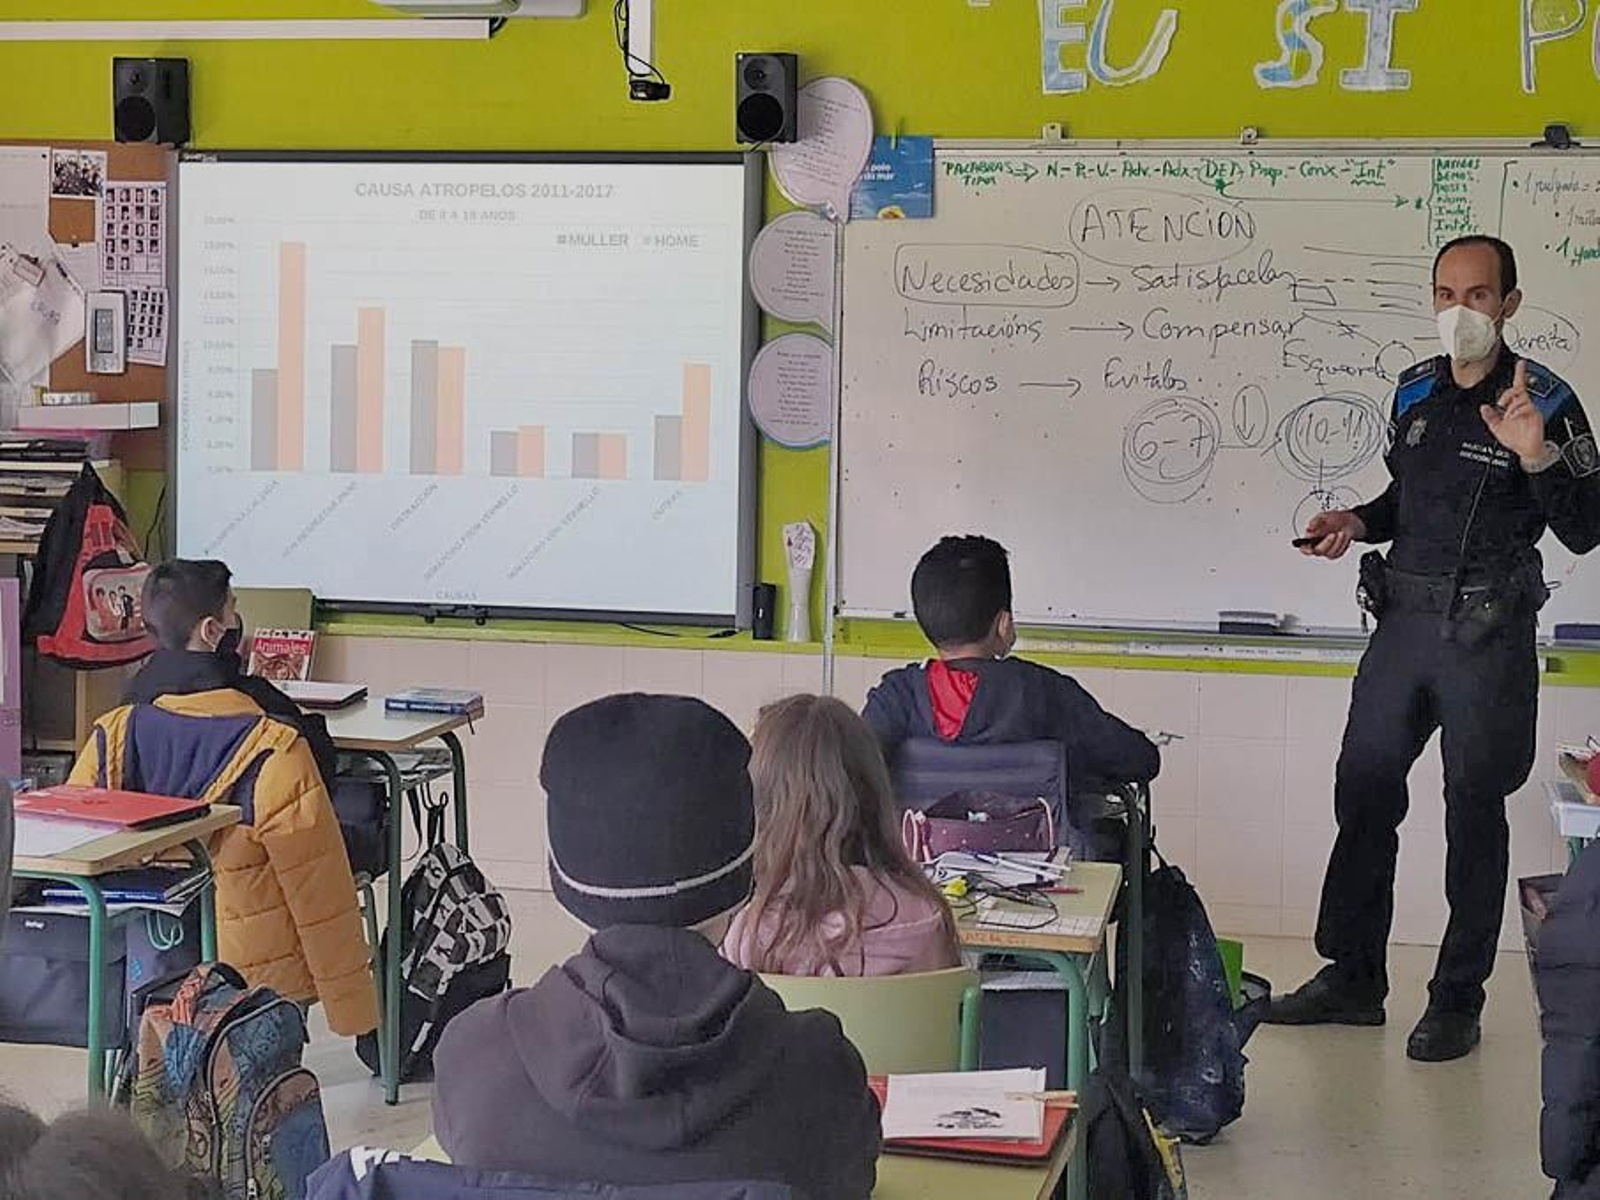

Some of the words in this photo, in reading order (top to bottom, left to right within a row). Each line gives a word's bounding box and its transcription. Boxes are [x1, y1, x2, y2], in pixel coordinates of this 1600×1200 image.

[1252, 0, 1418, 92] SI
[1520, 0, 1600, 94] P
[354, 182, 413, 198] CAUSA
[419, 182, 526, 198] ATROPELOS
[530, 181, 614, 198] 2011-2017
[568, 233, 629, 248] MULLER
[654, 234, 700, 249] HOME
[902, 260, 1074, 293] Necesidades
[1143, 307, 1304, 358] Compensar
[918, 358, 998, 398] Riscos
[255, 639, 307, 654] Animales
